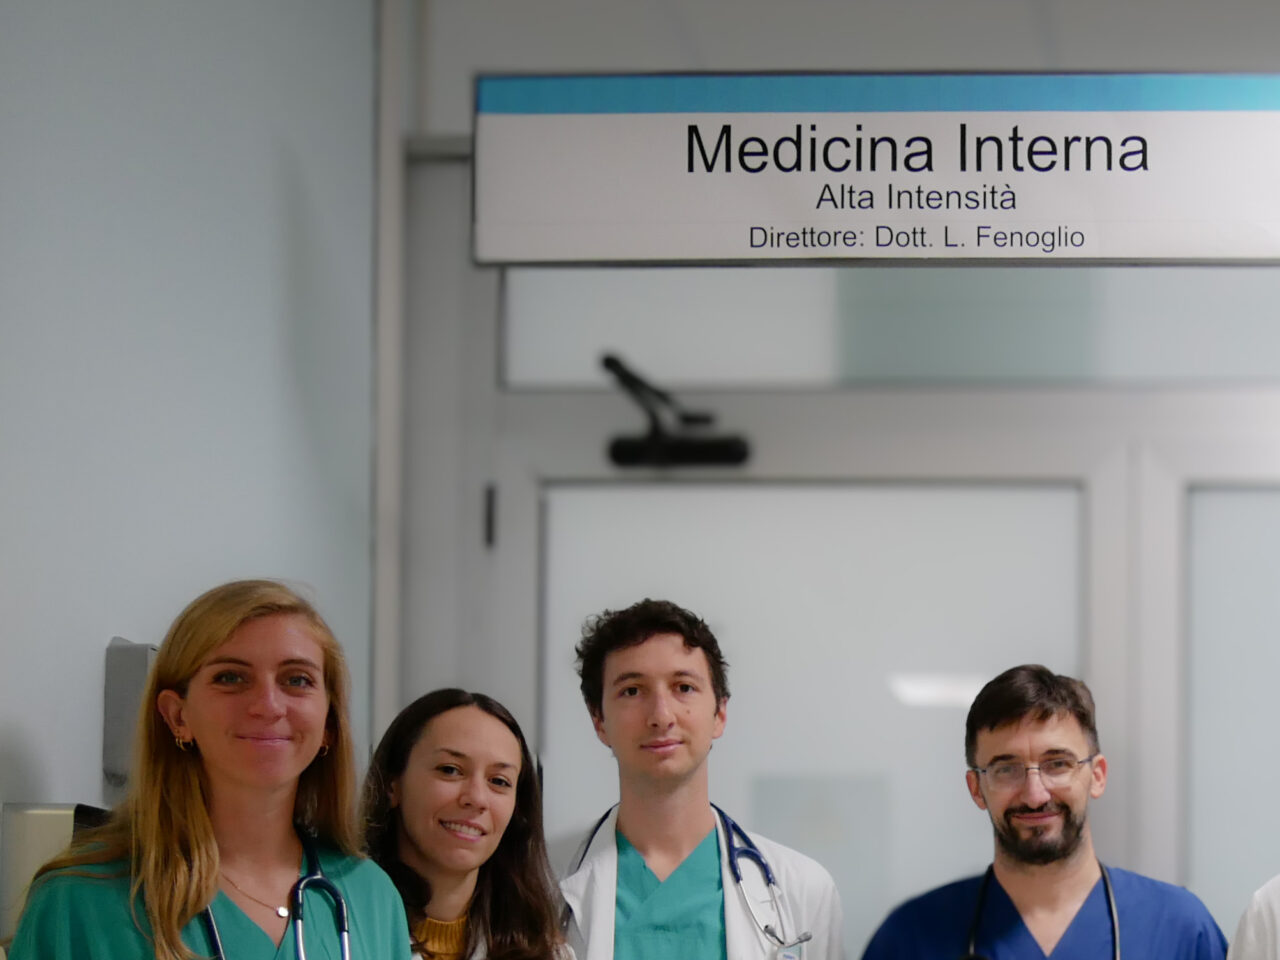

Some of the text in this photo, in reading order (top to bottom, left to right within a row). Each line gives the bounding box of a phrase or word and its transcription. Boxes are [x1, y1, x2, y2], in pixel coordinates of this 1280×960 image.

[687, 122, 1150, 174] Medicina Interna
[815, 183, 1017, 210] Alta Intensità
[749, 225, 1085, 253] Direttore: Dott. L. Fenoglio
